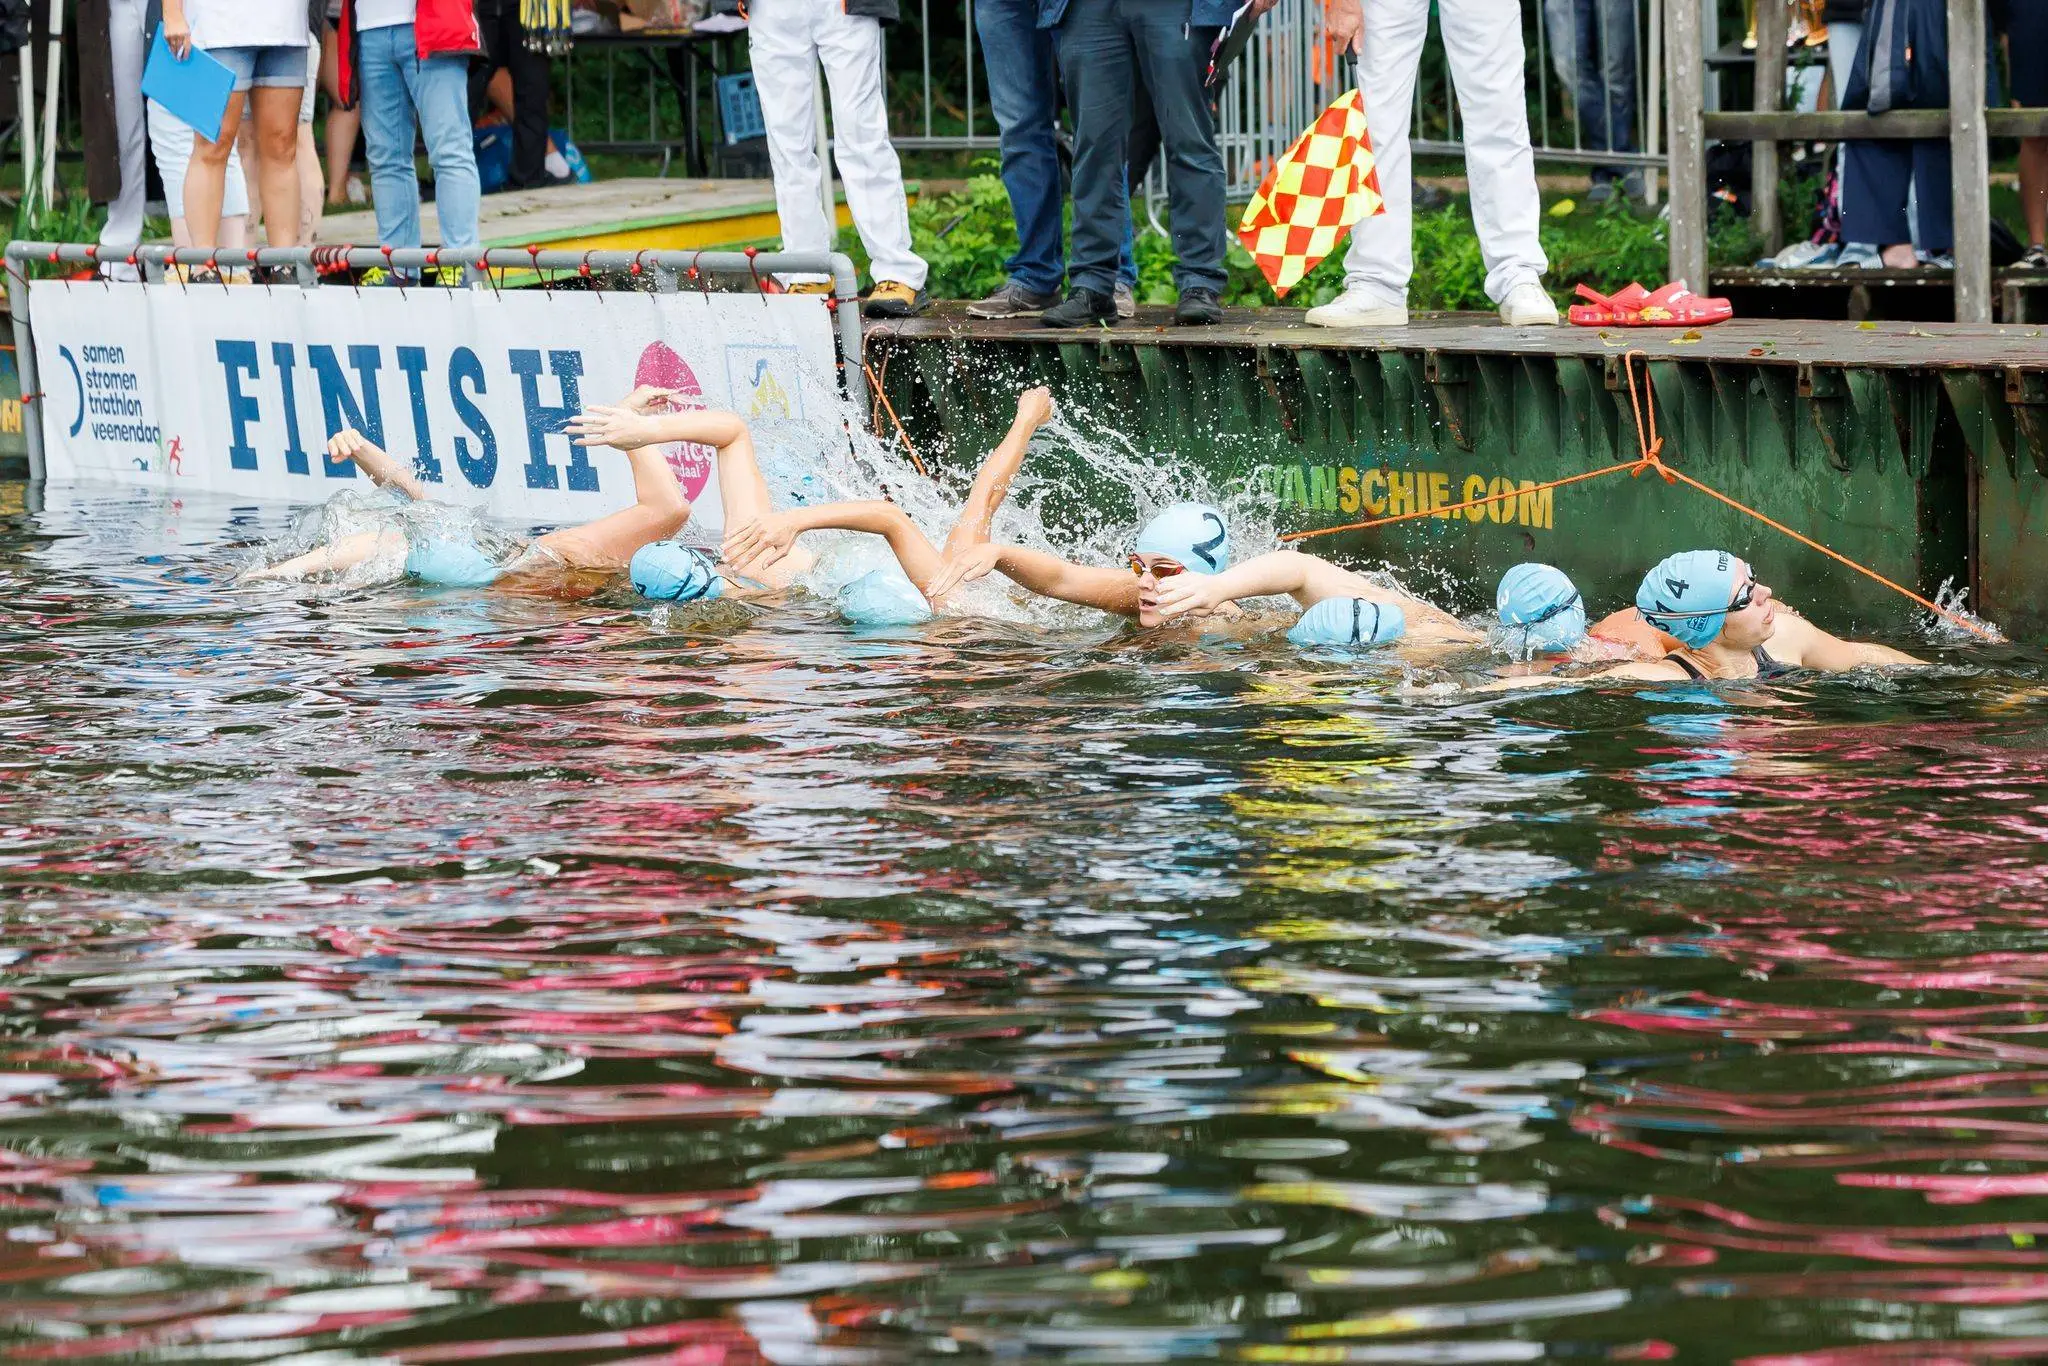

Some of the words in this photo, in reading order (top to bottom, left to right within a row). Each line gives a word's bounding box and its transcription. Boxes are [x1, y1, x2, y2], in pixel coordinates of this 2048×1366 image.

[82, 344, 125, 364] samen
[86, 367, 138, 390] stromen
[89, 392, 143, 417] triathlon
[214, 339, 600, 492] FINISH
[91, 419, 162, 443] veenendaa
